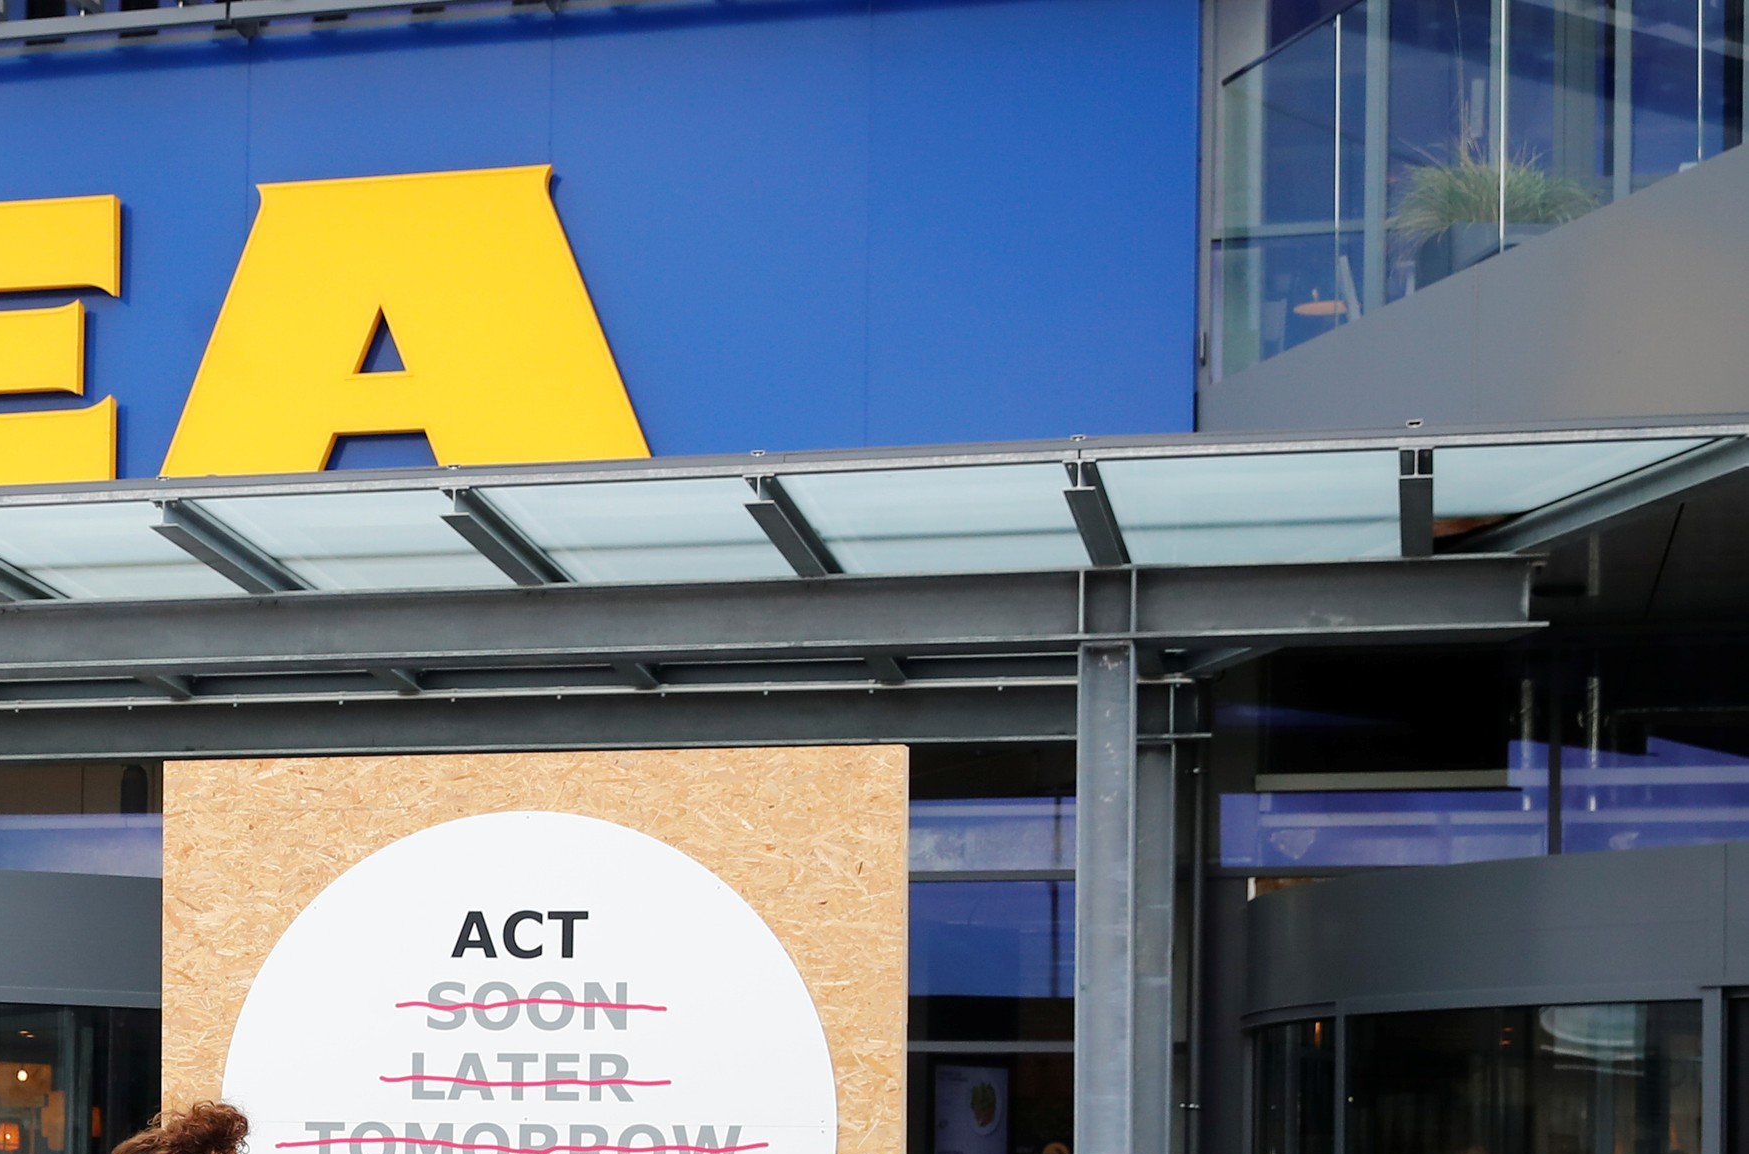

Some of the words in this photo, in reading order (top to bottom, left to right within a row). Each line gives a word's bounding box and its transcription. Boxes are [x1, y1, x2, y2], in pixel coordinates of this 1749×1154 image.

[451, 910, 589, 960] ACT
[425, 981, 629, 1032] SOON
[410, 1052, 635, 1103] LATER
